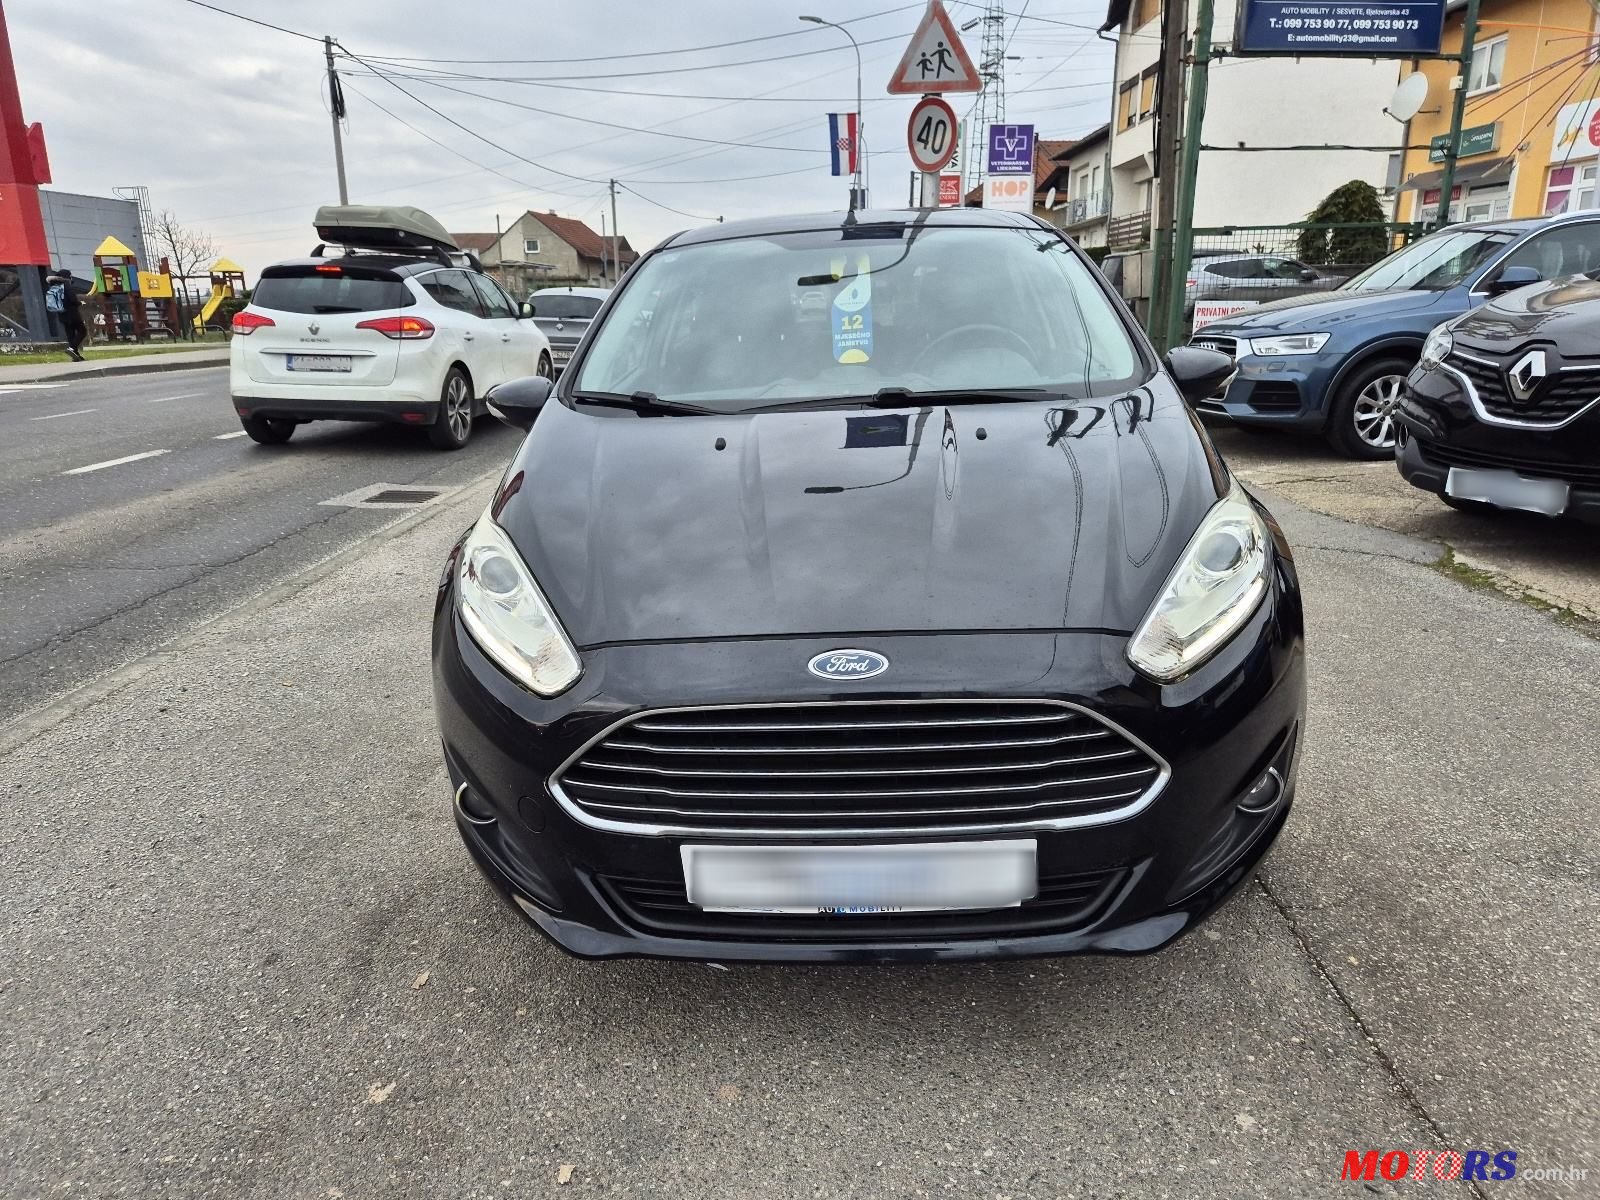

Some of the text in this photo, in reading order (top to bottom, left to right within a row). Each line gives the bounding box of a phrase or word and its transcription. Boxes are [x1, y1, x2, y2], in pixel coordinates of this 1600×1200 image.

[1336, 8, 1365, 16] SESVETE,
[1270, 18, 1419, 31] T.: 099 753 90 77, 099 753 90 73
[1296, 34, 1397, 43] automobility23@gmail.com
[917, 116, 947, 154] 40
[991, 181, 1029, 197] HOP
[1196, 307, 1229, 317] PRIVATNI
[841, 314, 864, 330] 12
[826, 655, 870, 672] Ford
